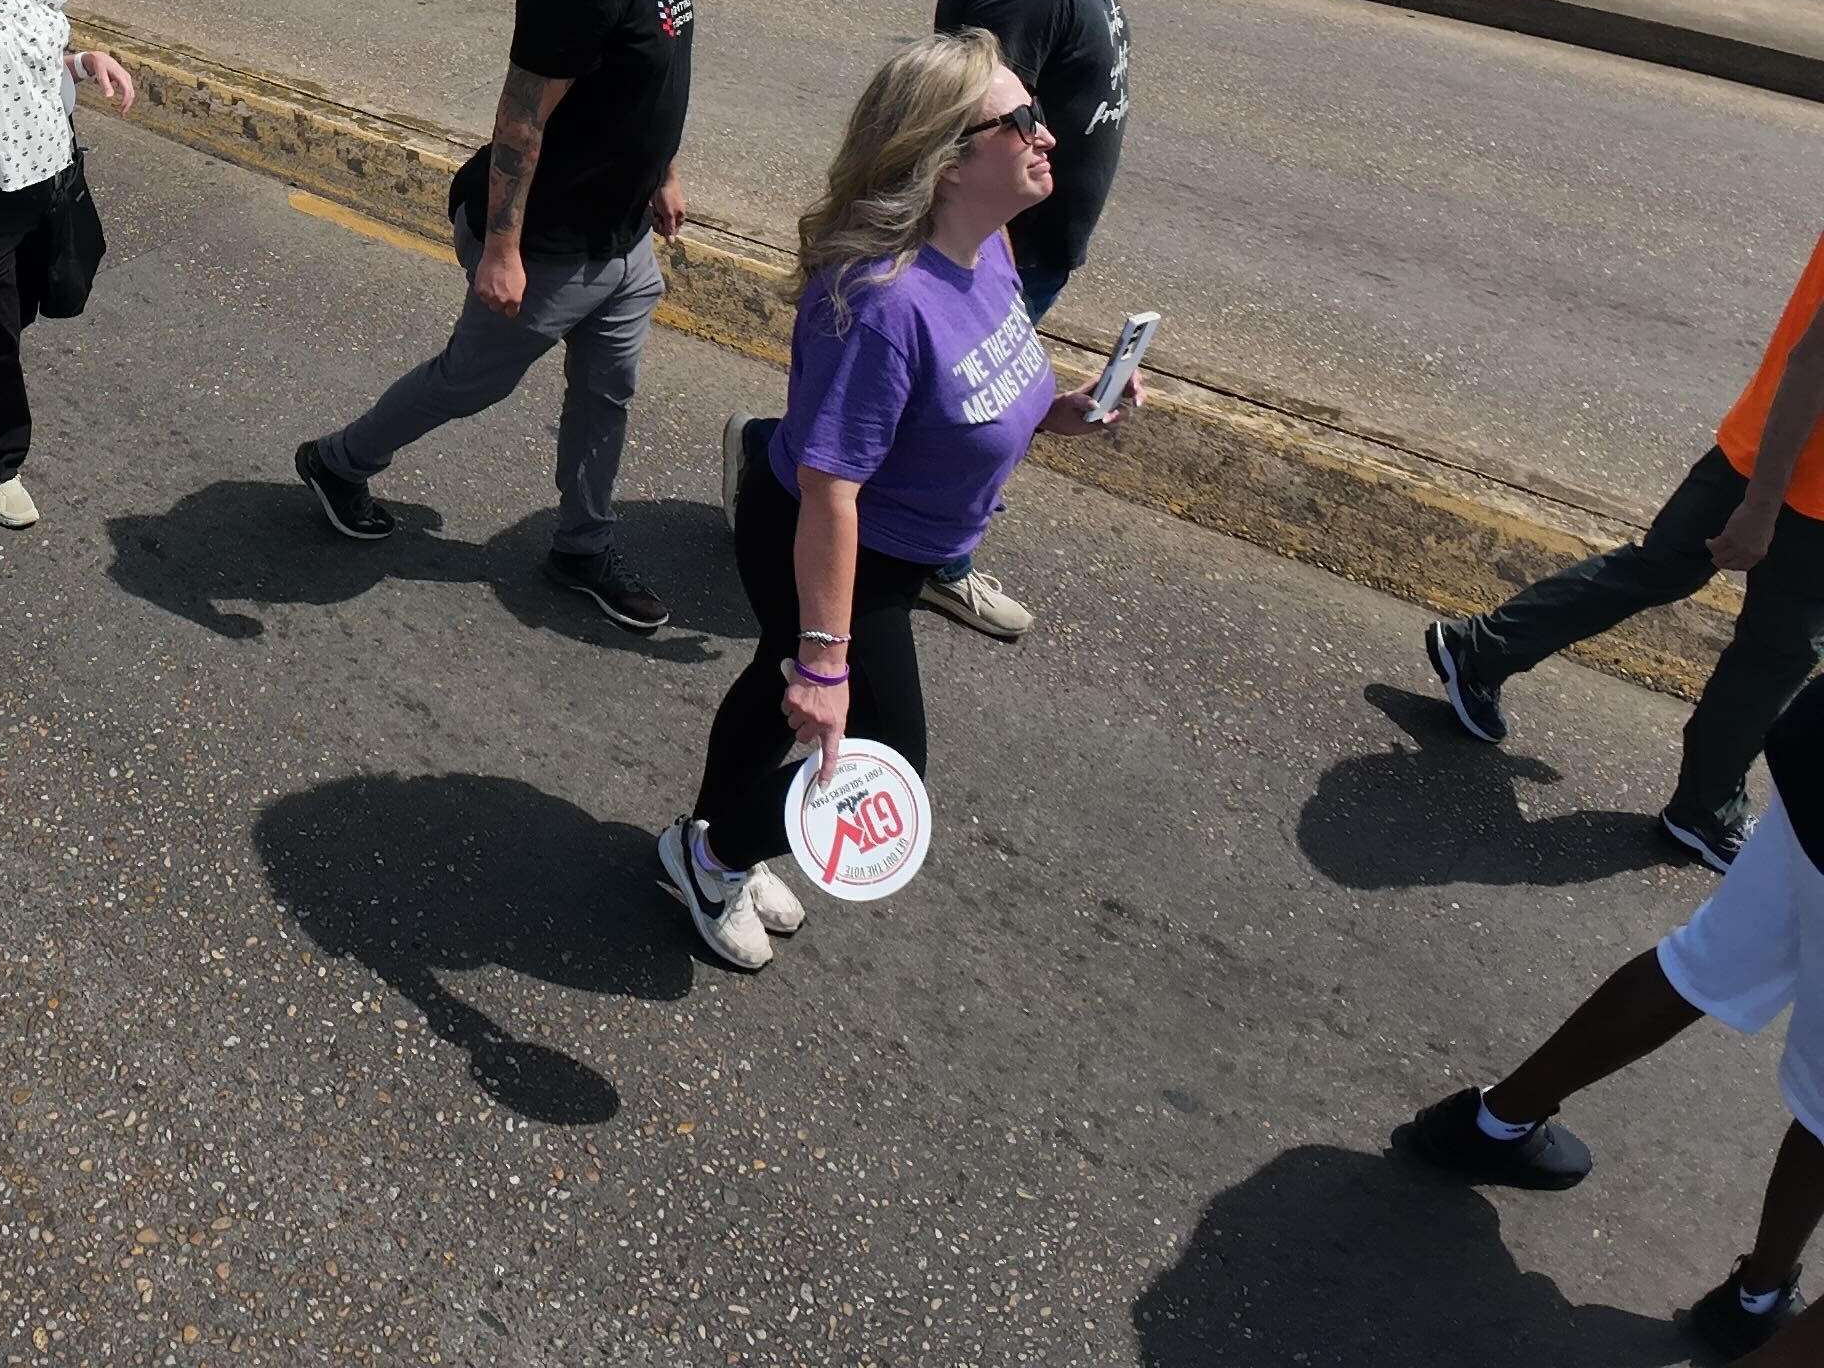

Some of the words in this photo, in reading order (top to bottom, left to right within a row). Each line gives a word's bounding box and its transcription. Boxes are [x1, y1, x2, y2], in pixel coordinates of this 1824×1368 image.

[980, 328, 1012, 368] THE
[961, 369, 1020, 424] MEANS
[895, 837, 909, 858] GET
[868, 863, 883, 877] THE
[884, 853, 898, 870] OUT
[845, 865, 867, 878] VOTE
